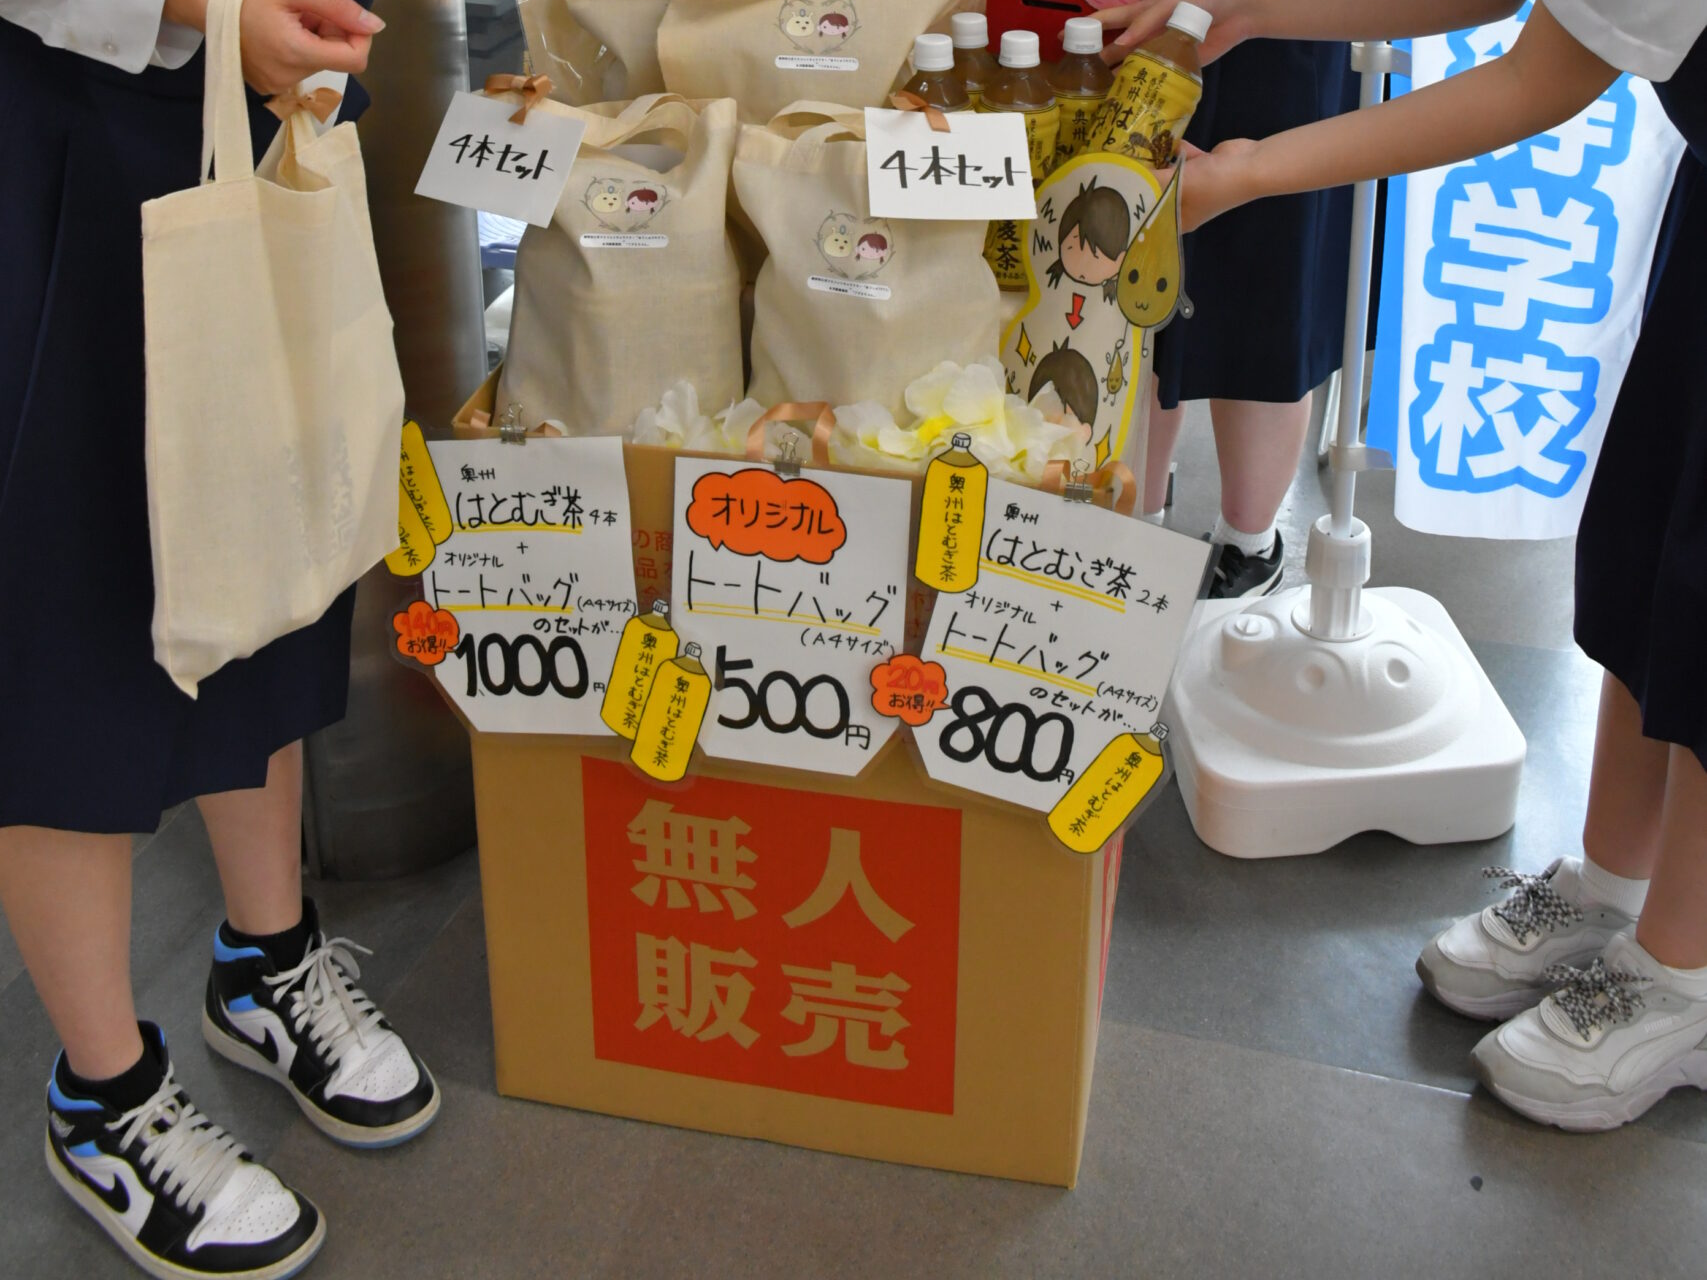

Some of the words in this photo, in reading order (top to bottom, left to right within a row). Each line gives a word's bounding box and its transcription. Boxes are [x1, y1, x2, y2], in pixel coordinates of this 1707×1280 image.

[448, 133, 555, 181] 4本セット
[879, 145, 1028, 190] 4本セット
[455, 485, 585, 531] はとむぎ茶
[711, 492, 834, 535] オリジナル
[939, 472, 966, 583] 奥州はとむぎ茶
[431, 570, 579, 611] トートバッグ
[444, 551, 504, 569] オリジナル
[688, 549, 898, 627] トートバッグ
[985, 528, 1137, 600] はとむぎ茶
[964, 590, 1037, 625] オリジナル
[941, 611, 1110, 680] トートバッグ
[652, 674, 692, 770] 奥州はとむぎ茶
[1068, 750, 1141, 838] 奥州はとむぎ茶
[626, 798, 916, 944] 無人
[633, 932, 912, 1072] 販売
